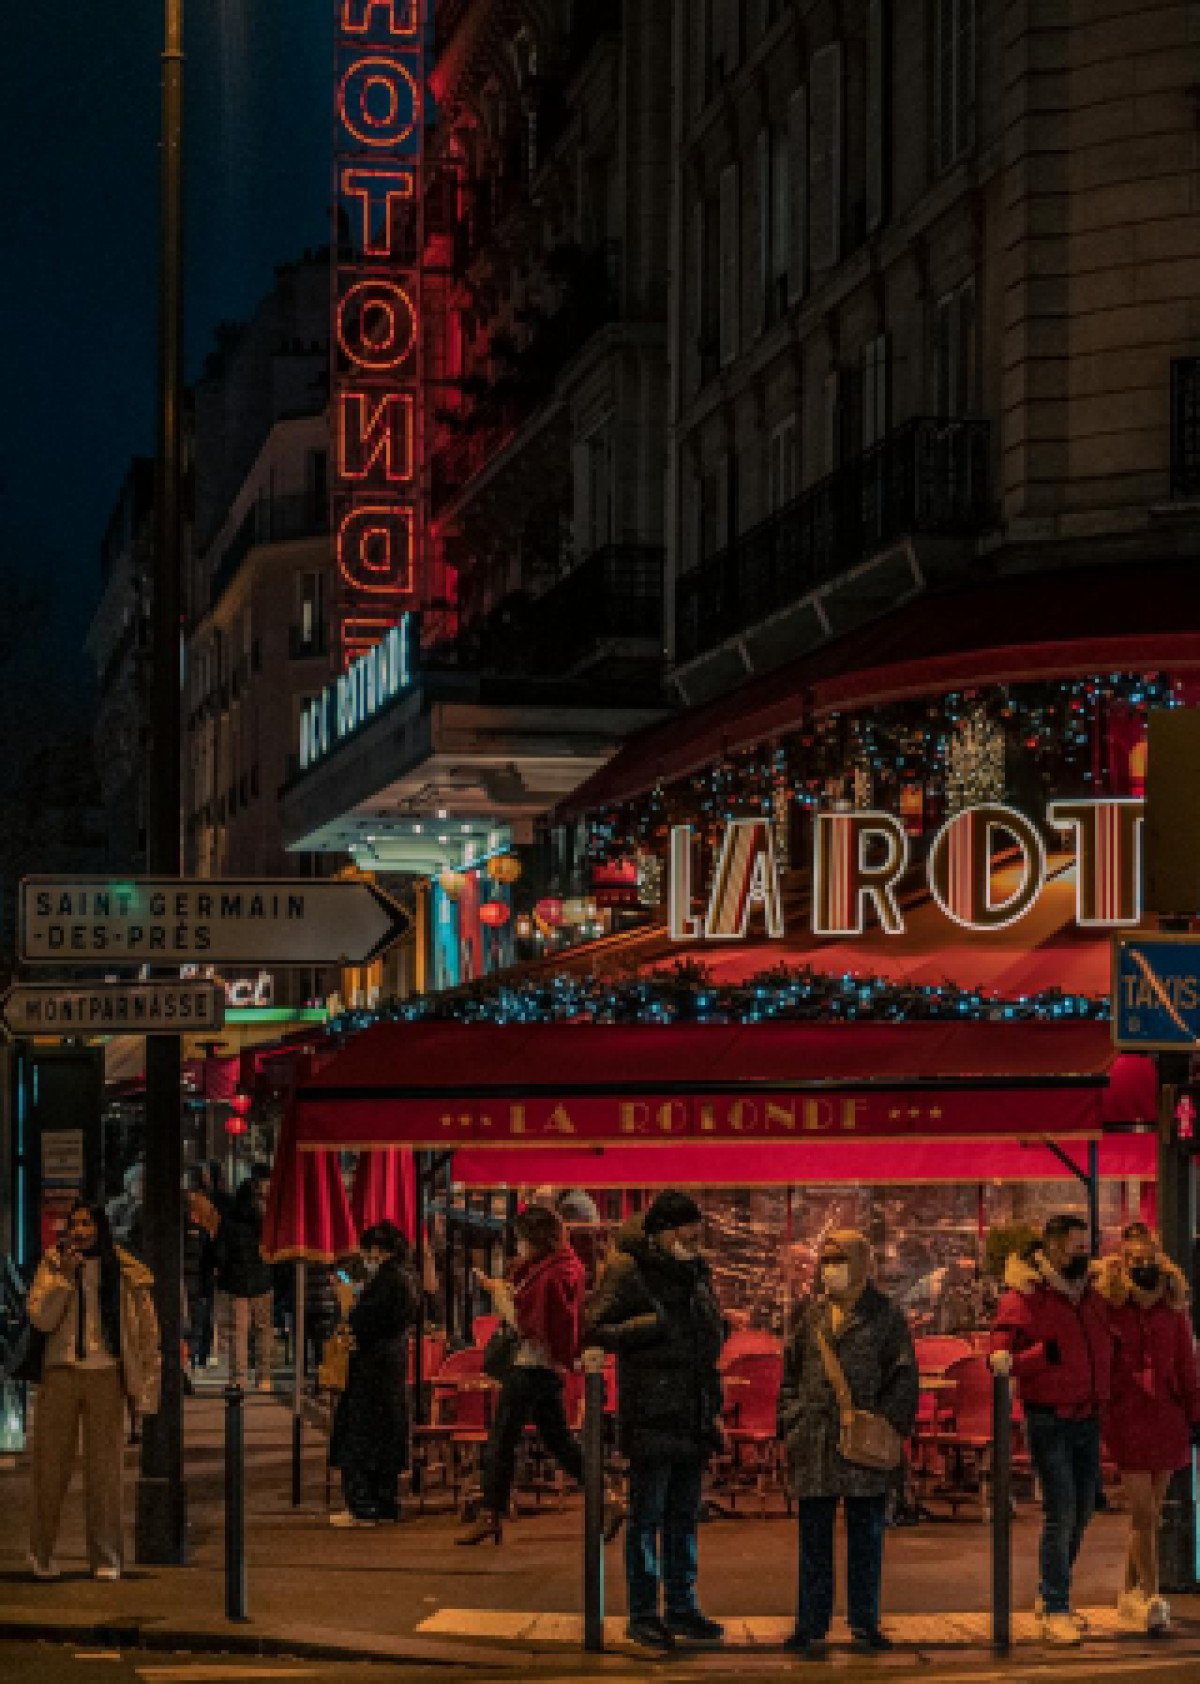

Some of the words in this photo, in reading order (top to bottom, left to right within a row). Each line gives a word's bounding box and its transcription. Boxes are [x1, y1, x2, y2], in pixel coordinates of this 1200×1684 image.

[669, 815, 784, 941] LA
[35, 891, 133, 917] SAINT
[149, 892, 305, 919] GERMAIN
[25, 992, 209, 1021] MONTPARNASSE
[508, 1101, 577, 1134] LA
